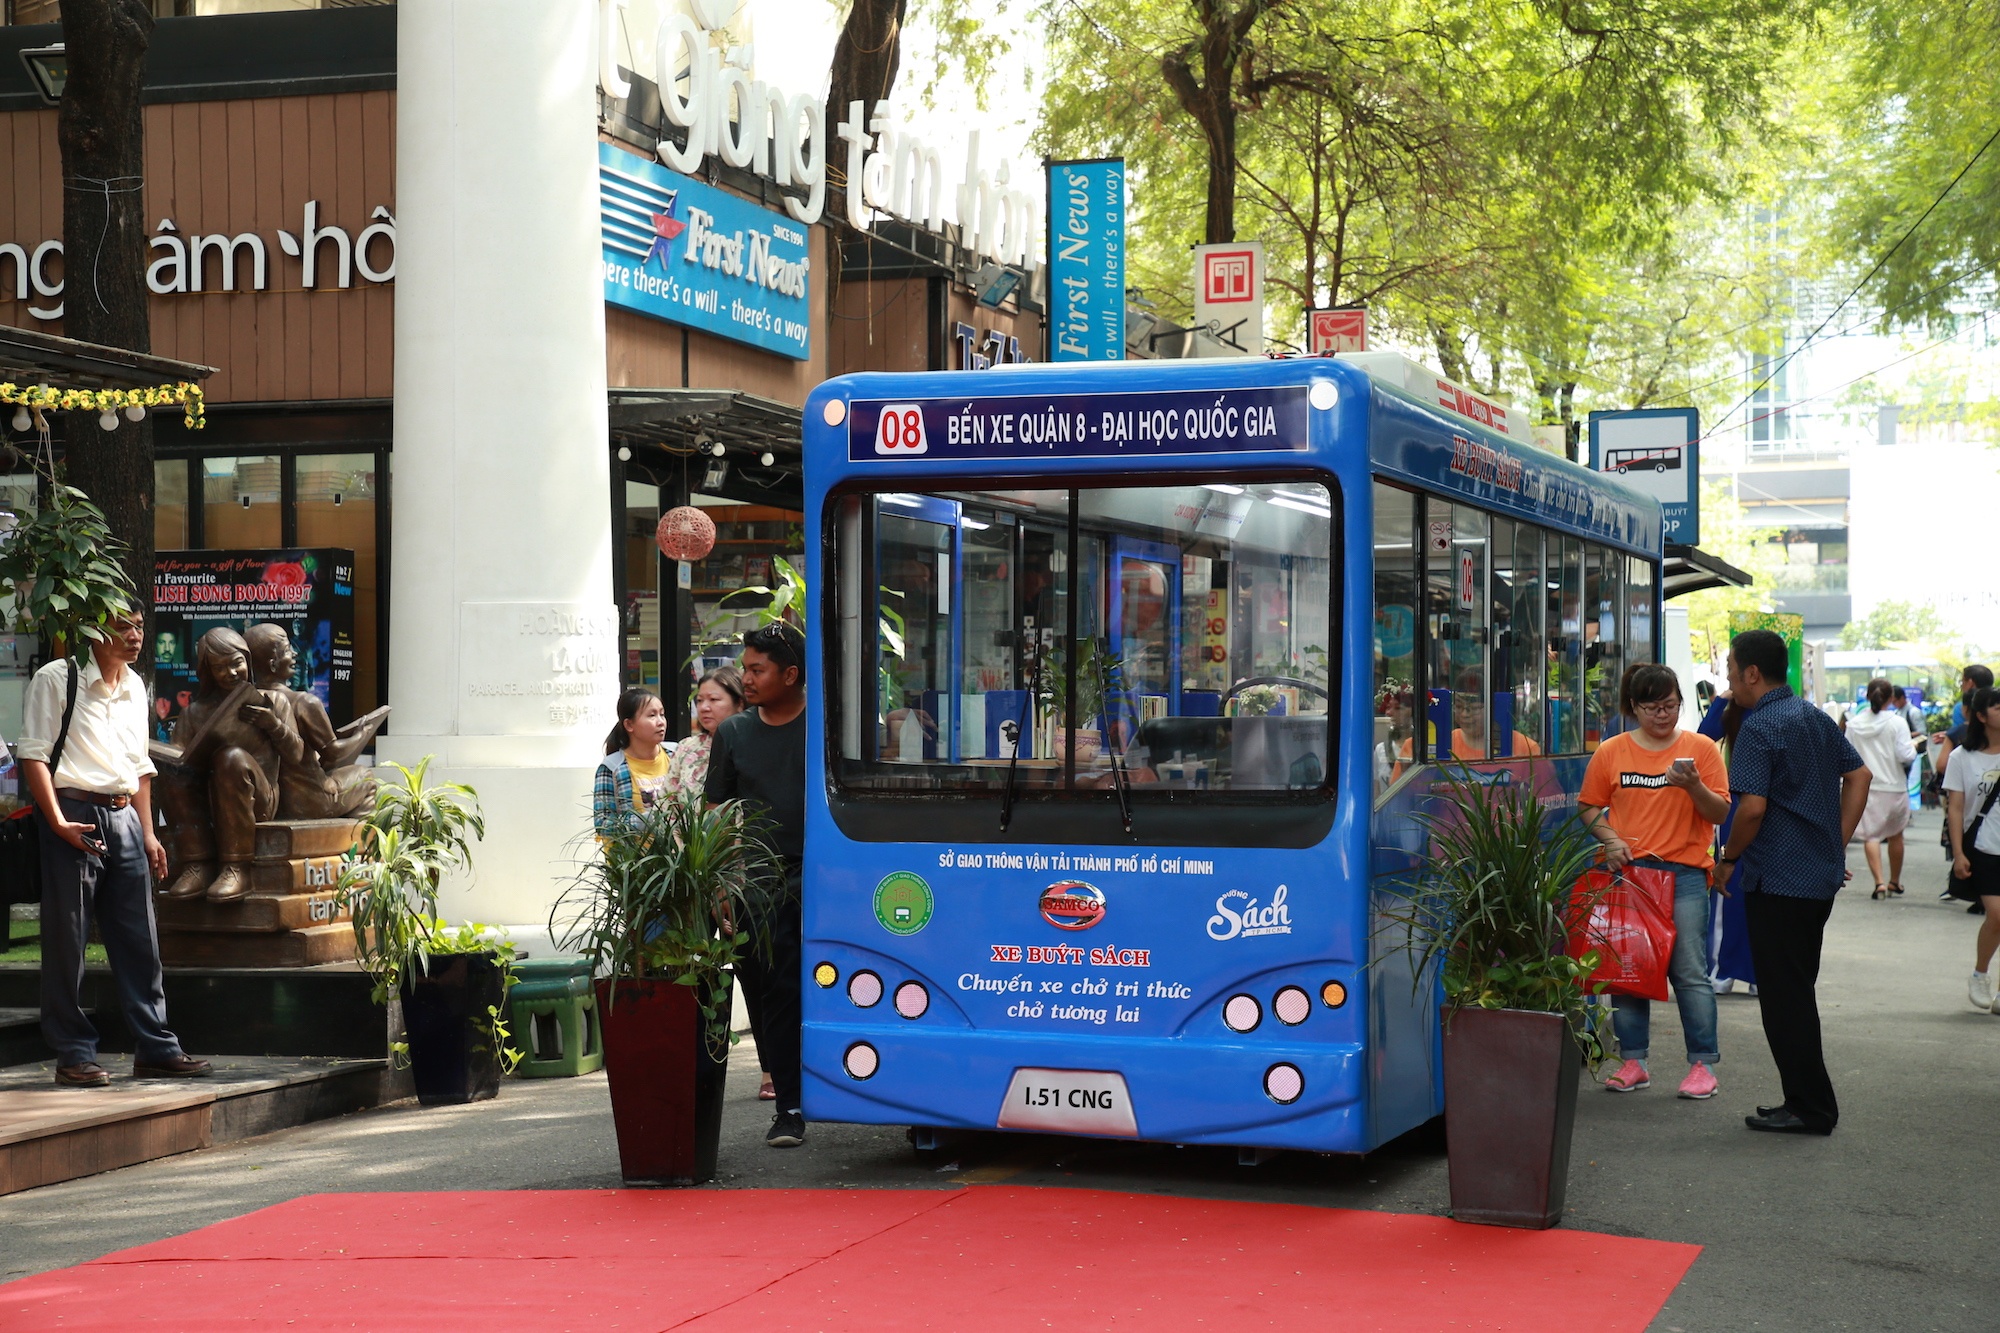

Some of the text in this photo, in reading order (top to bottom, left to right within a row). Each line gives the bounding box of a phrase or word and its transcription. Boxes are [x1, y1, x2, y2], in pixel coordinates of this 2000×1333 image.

[1106, 168, 1122, 206] way
[1106, 210, 1118, 222] a
[683, 206, 745, 278] First
[772, 223, 804, 248] SINCE 1994
[1102, 229, 1118, 289] there's
[633, 268, 679, 302] there's
[682, 287, 691, 304] a
[694, 289, 718, 314] will
[731, 297, 772, 331] there's
[774, 317, 782, 335] a
[784, 319, 808, 348] way
[1059, 272, 1090, 358] First
[1102, 310, 1118, 342] will
[1106, 349, 1118, 360] a
[880, 409, 921, 450] 08
[947, 402, 985, 445] BẾN
[989, 414, 1014, 444] XE
[1018, 405, 1071, 449] QUẬN
[1075, 414, 1086, 443] 8
[1101, 410, 1133, 447] ĐẠI
[1138, 409, 1179, 446] HỌC
[1184, 395, 1239, 441] QUỐC
[1243, 406, 1277, 438] GIA
[1450, 434, 1469, 476] XE
[181, 562, 201, 573] you
[247, 558, 265, 569] love
[165, 572, 216, 584] Favourite
[334, 582, 352, 596] New
[1462, 558, 1473, 602] 08
[190, 583, 231, 603] SONG
[234, 583, 278, 602] BOOK
[281, 583, 312, 602] 1997
[197, 603, 221, 612] Collection
[239, 603, 250, 611] New
[255, 603, 274, 611] Famous
[274, 603, 293, 612] English
[293, 602, 308, 612] Songs
[231, 612, 248, 620] Chords
[294, 612, 308, 620] Piano
[333, 648, 353, 659] ENGLISH
[334, 668, 350, 682] 1997
[469, 683, 524, 697] PARACEL
[526, 681, 553, 696] AND
[1621, 774, 1668, 788] WOMANI
[938, 849, 1214, 875] SỞ GIAO THÔNG VẬN TẢI THÀNH PHỐ HỒ CHÍ MINH
[1042, 897, 1100, 912] SAMCO
[1206, 884, 1293, 941] Sách
[990, 943, 1151, 967] XE BUÝT SÁCH
[957, 973, 1192, 1000] Chuyến xe chở tri thức
[1007, 1001, 1140, 1025] chở tương lai
[1025, 1086, 1113, 1110] I.51 CNG
